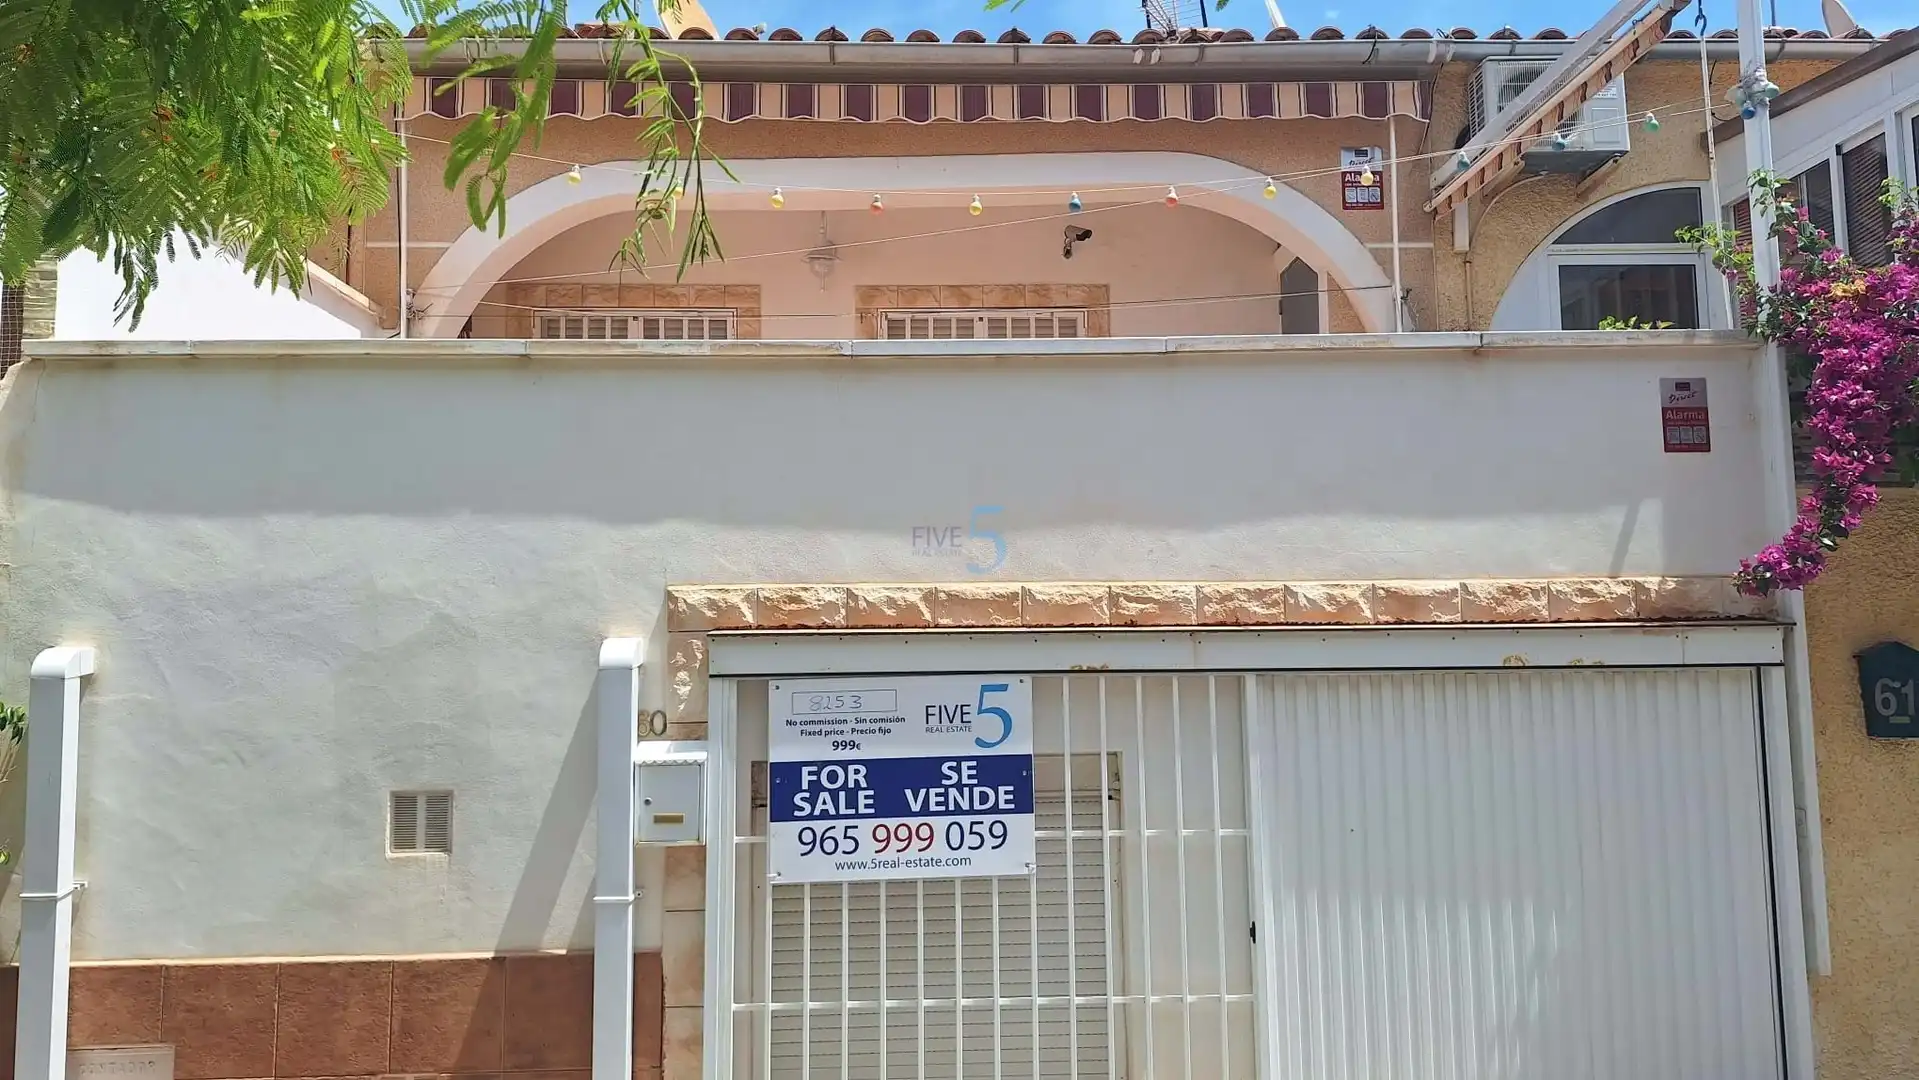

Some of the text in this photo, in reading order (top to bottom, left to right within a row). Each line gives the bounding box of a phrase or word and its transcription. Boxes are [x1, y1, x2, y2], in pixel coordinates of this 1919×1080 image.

[1345, 173, 1380, 182] Alaa
[1666, 409, 1704, 420] Alarma
[809, 695, 862, 711] 8253
[1875, 678, 1916, 716] 61
[785, 719, 798, 727] No
[799, 718, 848, 726] commission
[854, 716, 868, 725] Sin
[869, 716, 906, 724] comisión
[925, 704, 972, 725] FIVE
[975, 683, 1013, 748] 5
[800, 728, 823, 736] Fixed
[824, 728, 845, 738] price
[851, 727, 877, 735] Precio
[878, 726, 892, 736] fijo
[946, 725, 972, 733] ESTATE
[832, 740, 862, 751] 999€
[801, 764, 868, 790] FOR
[941, 760, 978, 786] SE
[793, 790, 876, 817] SALE
[904, 785, 1015, 812] VENDE
[797, 820, 1008, 857] 965 999 059
[835, 856, 972, 871] www.5real-estate.com
